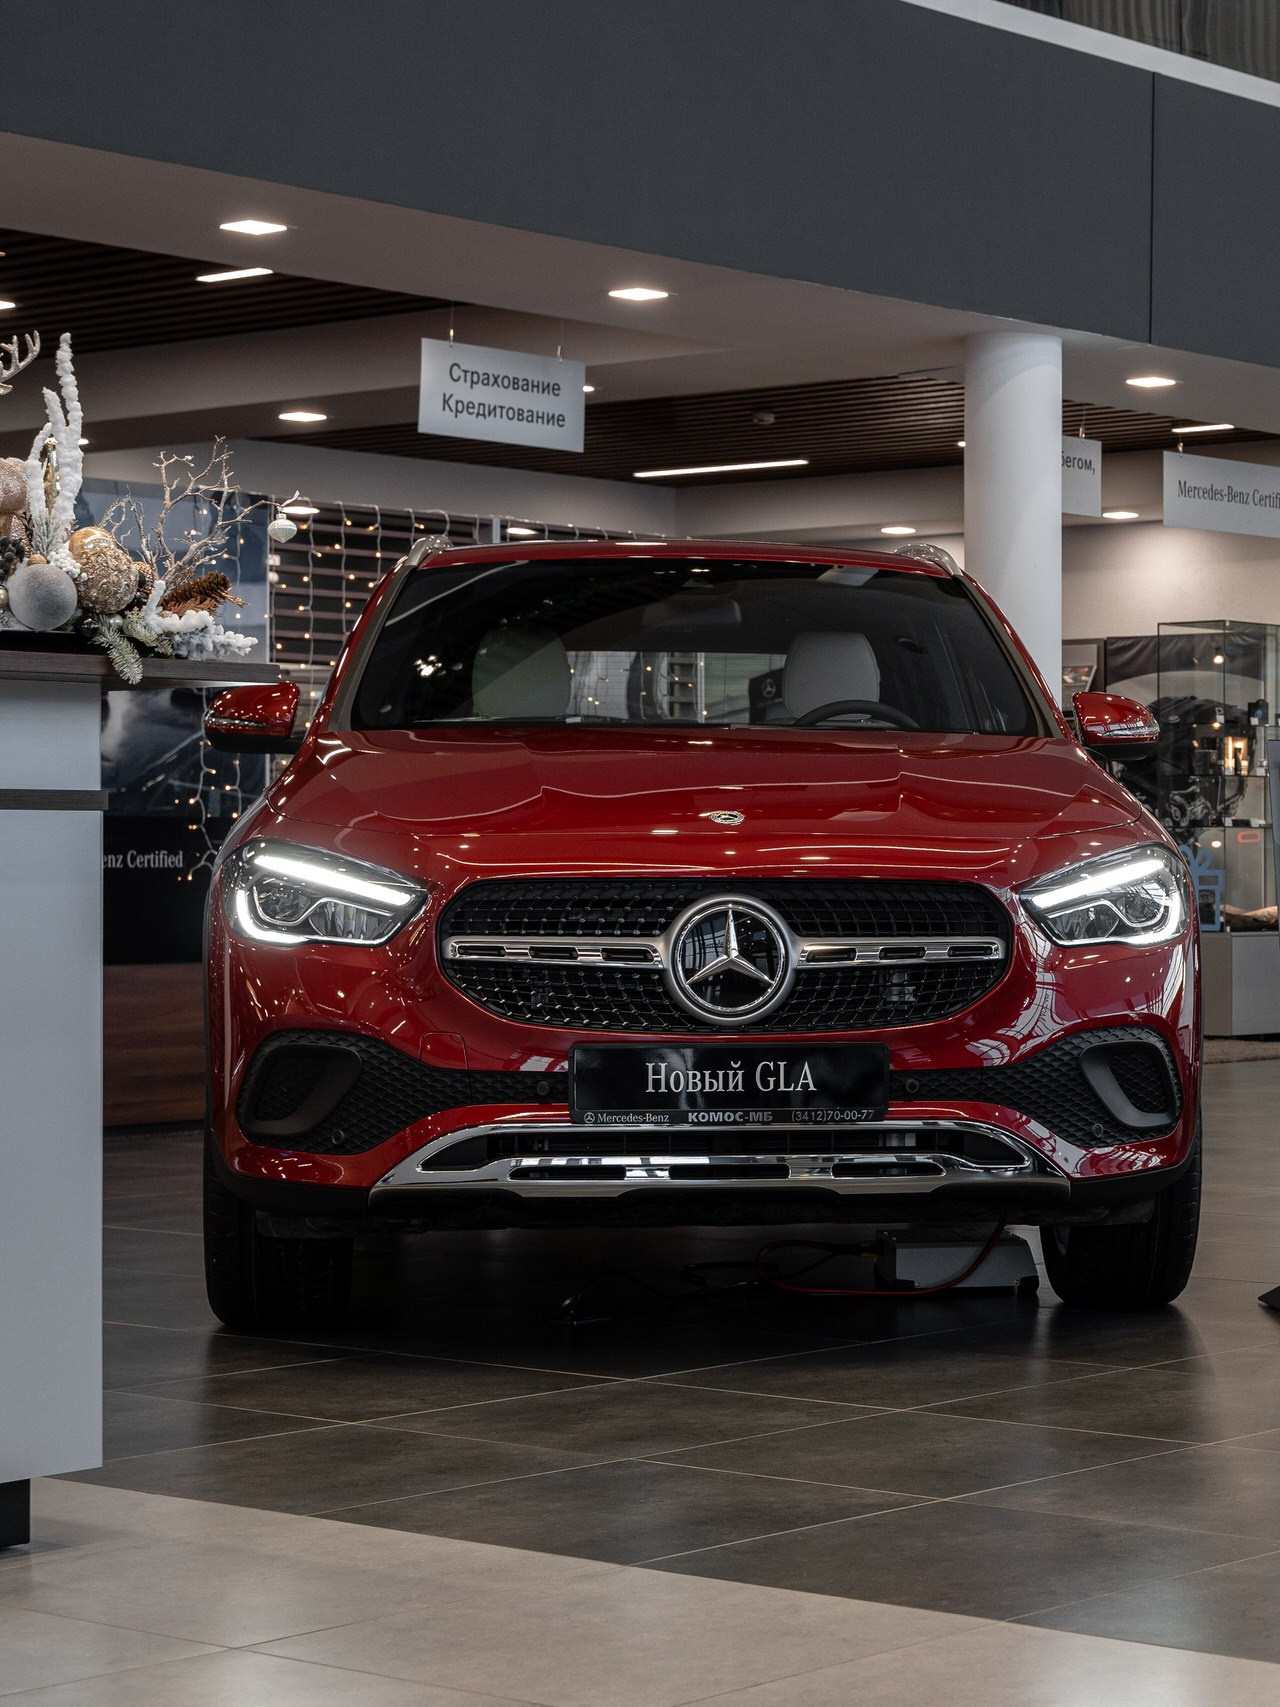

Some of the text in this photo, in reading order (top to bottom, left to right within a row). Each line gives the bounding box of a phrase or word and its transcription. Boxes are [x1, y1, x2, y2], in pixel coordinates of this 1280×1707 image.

[448, 362, 562, 397] Страхование
[441, 392, 567, 428] Кредитование
[1178, 479, 1250, 505] Mercedes-Benz
[126, 849, 184, 868] Certified
[645, 1060, 818, 1093] Новый GLA
[597, 1110, 876, 1123] Mercedes-Benz КОМОС-МБ (3412)70-00-77
